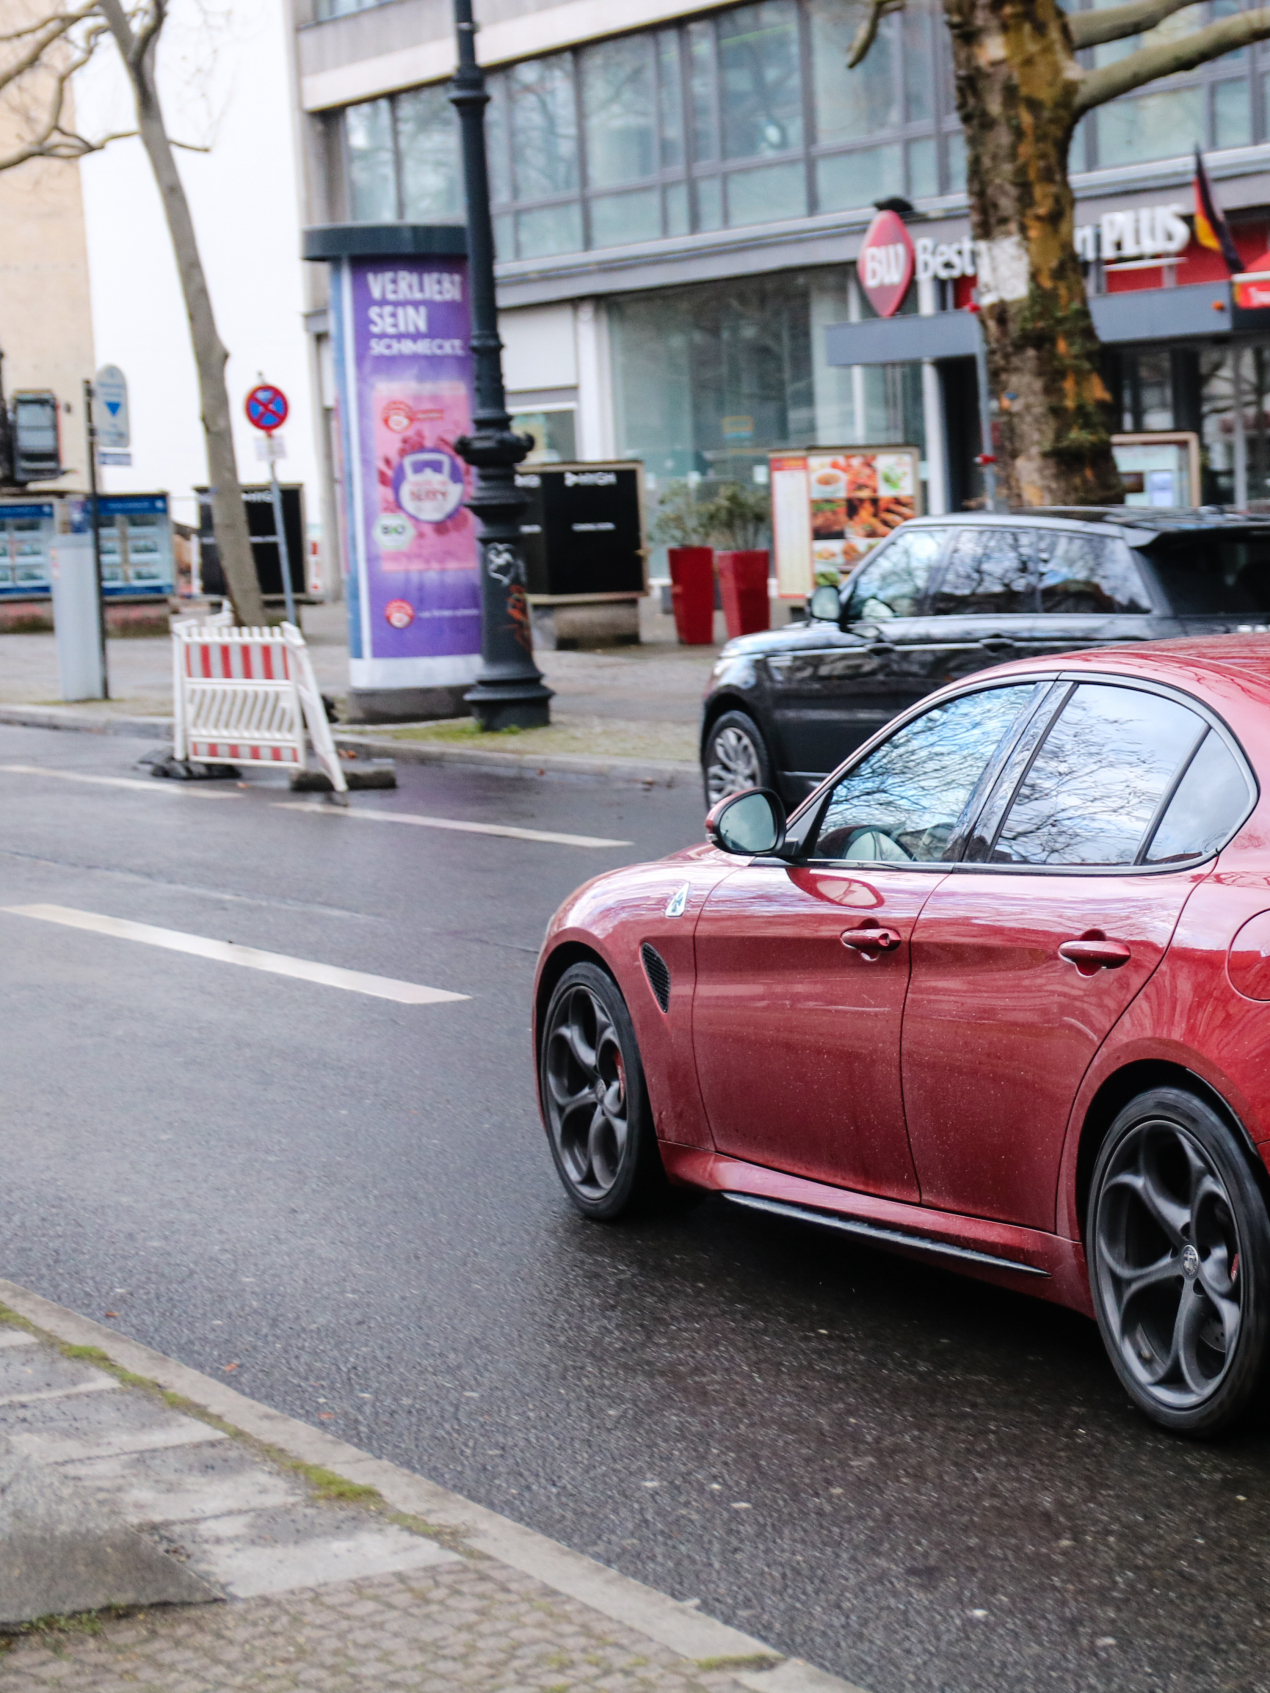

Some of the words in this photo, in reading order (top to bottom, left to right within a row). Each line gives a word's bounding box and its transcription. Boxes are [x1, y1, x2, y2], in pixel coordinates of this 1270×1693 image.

[865, 242, 904, 288] BW
[915, 236, 978, 281] Best
[1101, 203, 1191, 259] PLUS
[367, 304, 428, 335] SEIN
